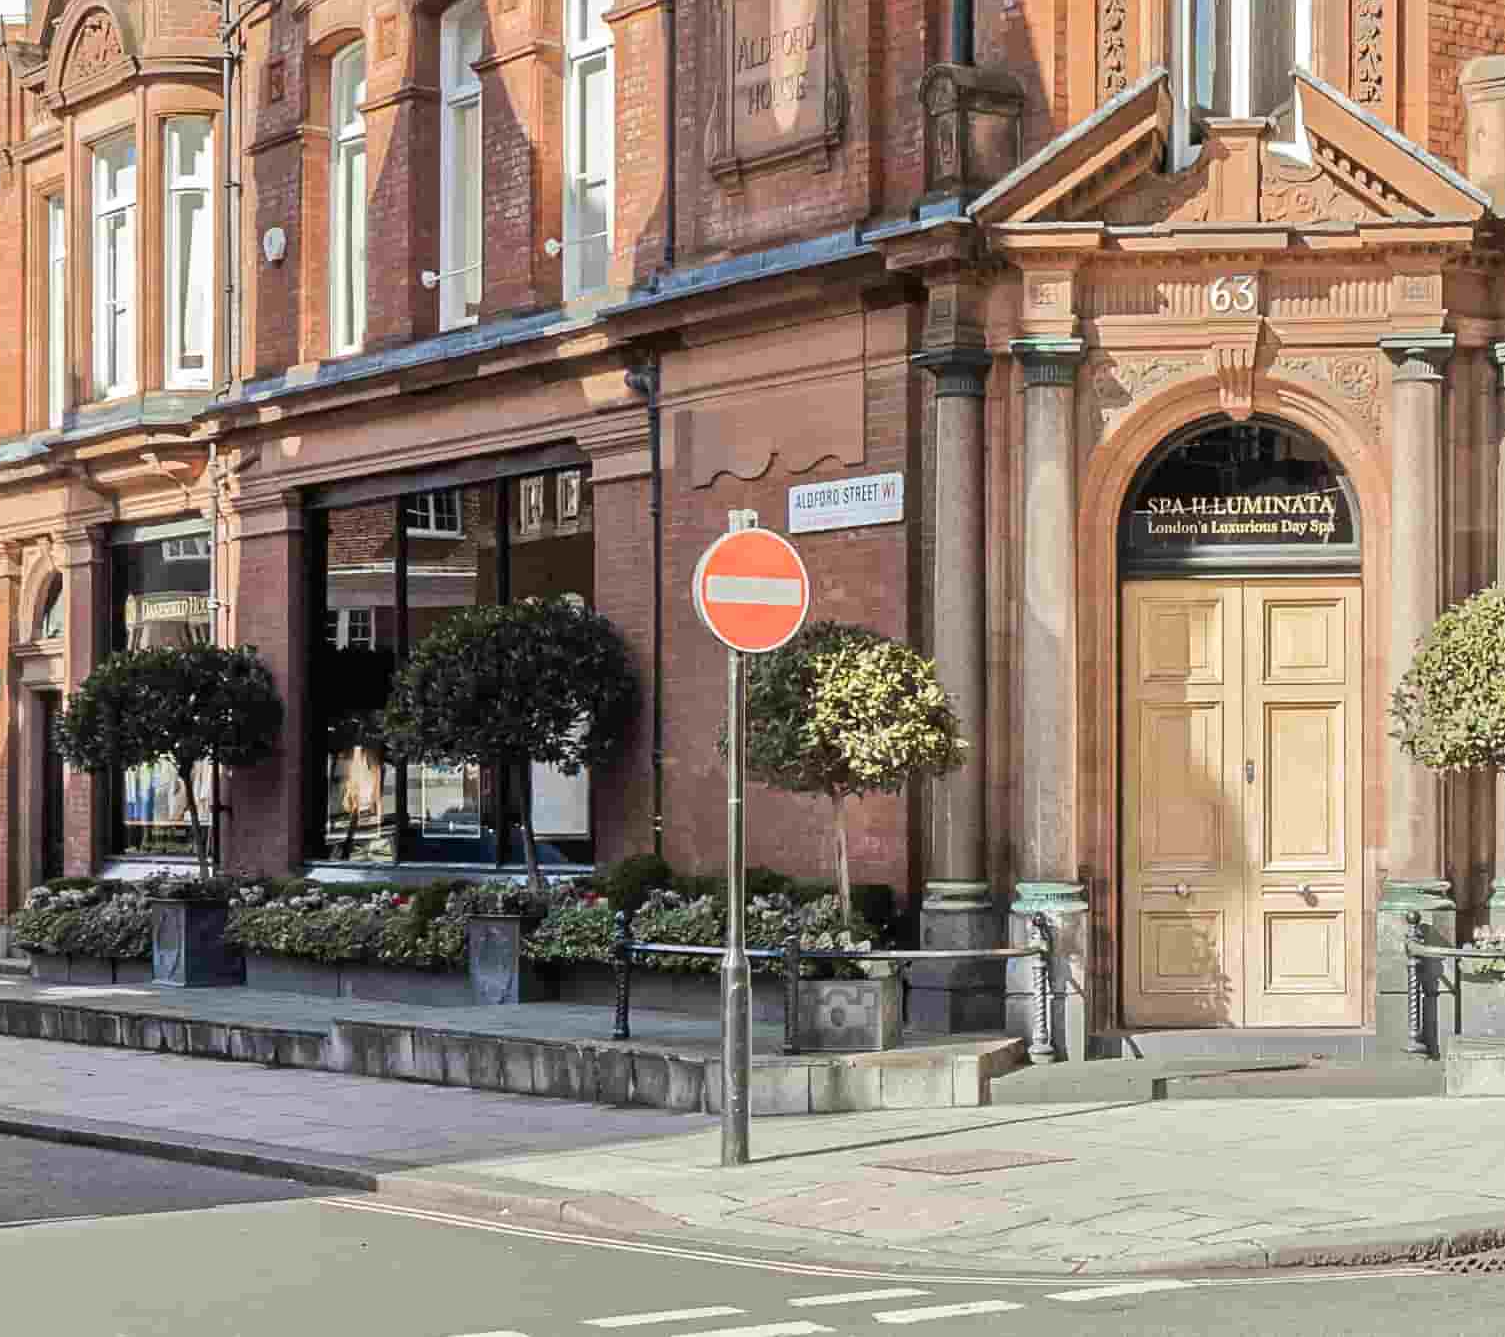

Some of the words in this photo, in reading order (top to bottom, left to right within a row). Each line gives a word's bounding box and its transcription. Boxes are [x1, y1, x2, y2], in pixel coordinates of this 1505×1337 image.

[1208, 274, 1256, 313] 63
[794, 488, 840, 509] ALDFORD
[843, 483, 879, 508] STREET
[1148, 497, 1186, 515] SPA
[1192, 495, 1335, 516] ILLUMINATA
[1148, 520, 1208, 534] London's
[1212, 519, 1278, 534] Luxurious
[1281, 519, 1308, 537] Day
[1309, 519, 1337, 539] Spa
